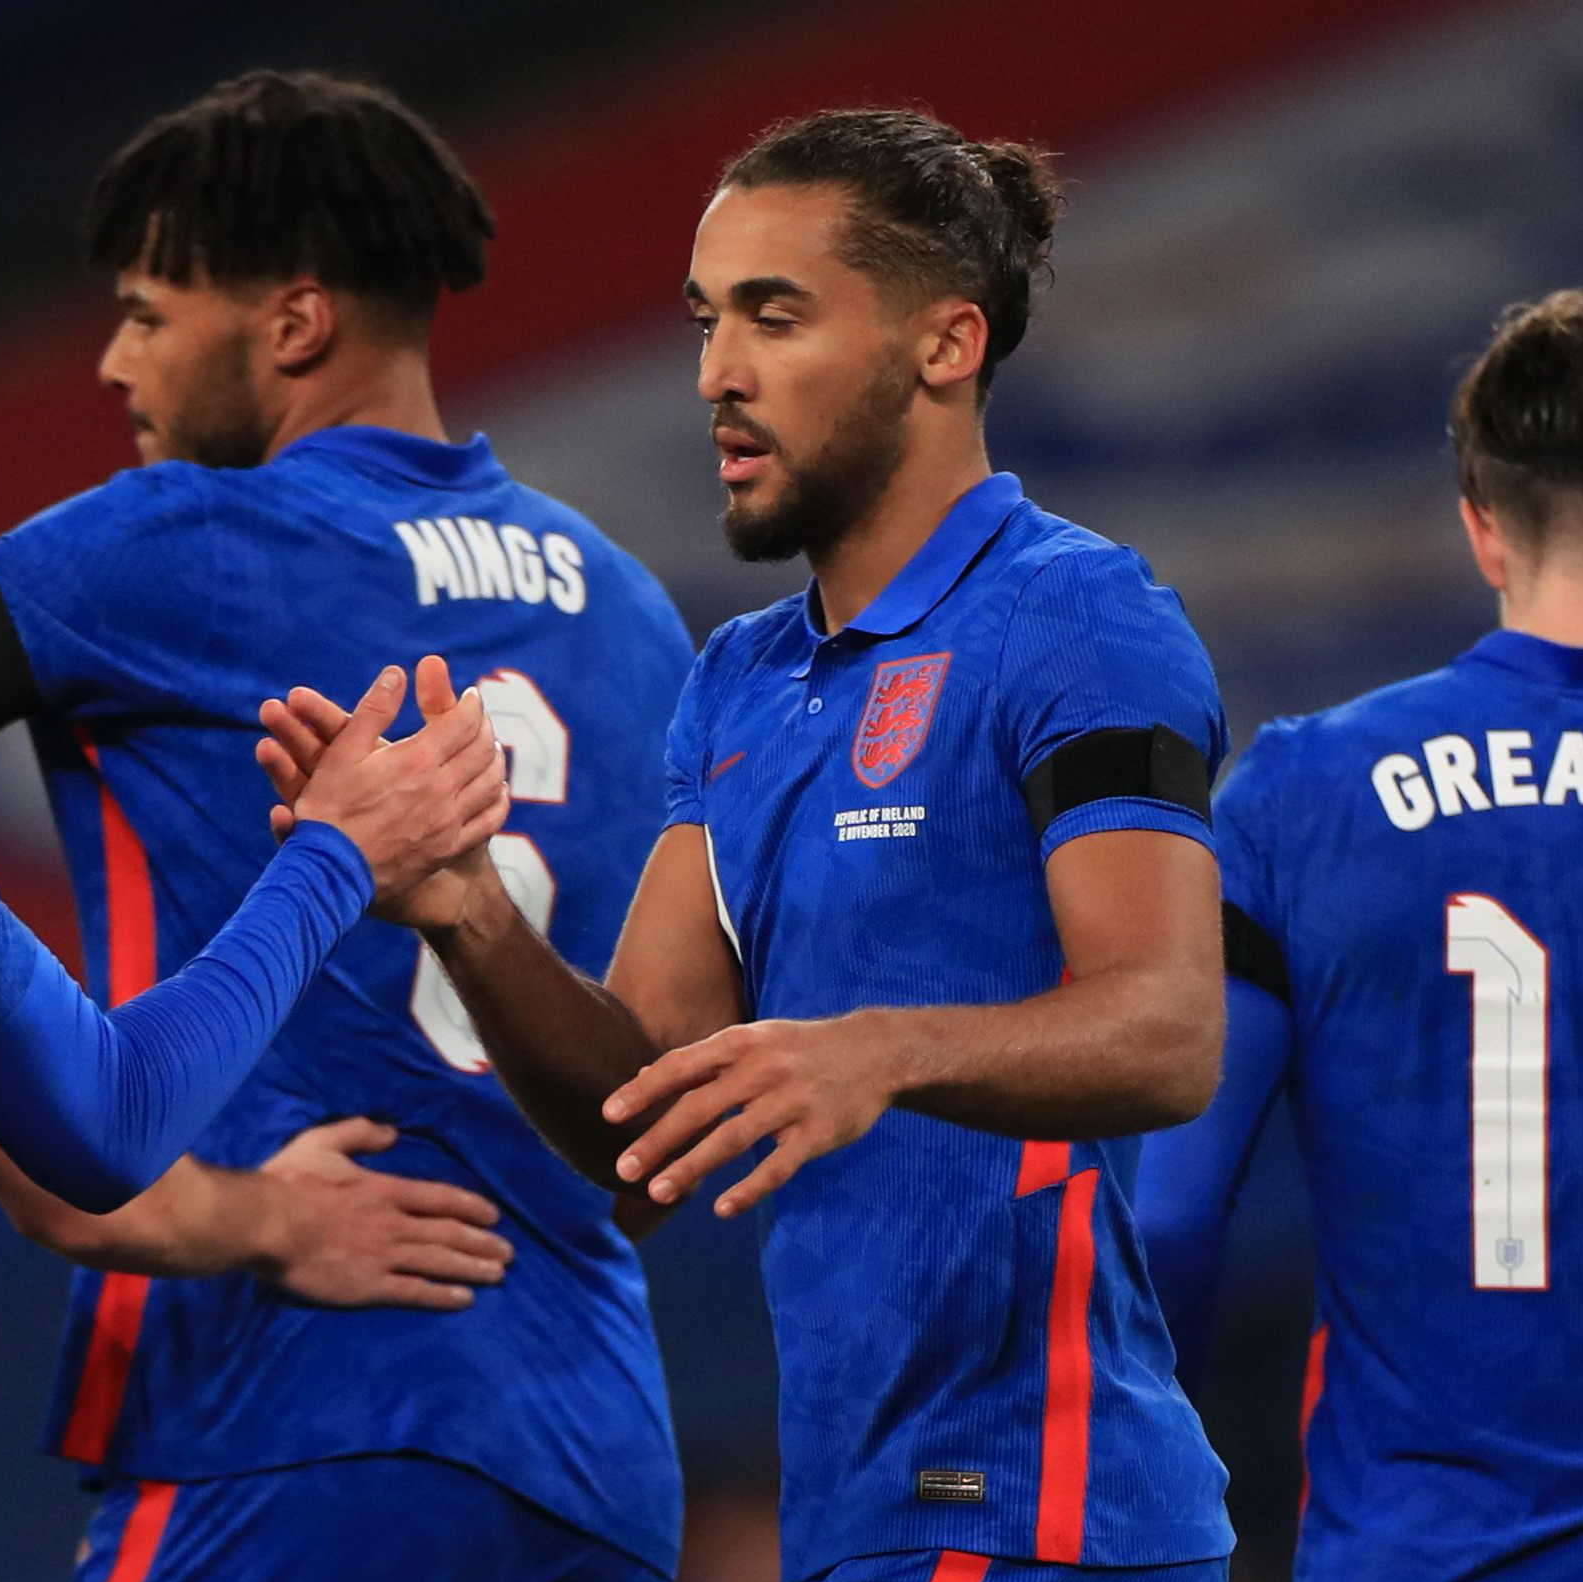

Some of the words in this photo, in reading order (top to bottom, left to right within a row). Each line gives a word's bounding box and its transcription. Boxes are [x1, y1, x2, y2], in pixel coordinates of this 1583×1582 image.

[394, 517, 586, 615] MINGS
[834, 811, 867, 826] REPUBLIC
[869, 808, 880, 822] OF
[881, 806, 925, 821] IRELAND
[846, 825, 890, 839] NOVEMBER
[892, 822, 916, 836] 2020
